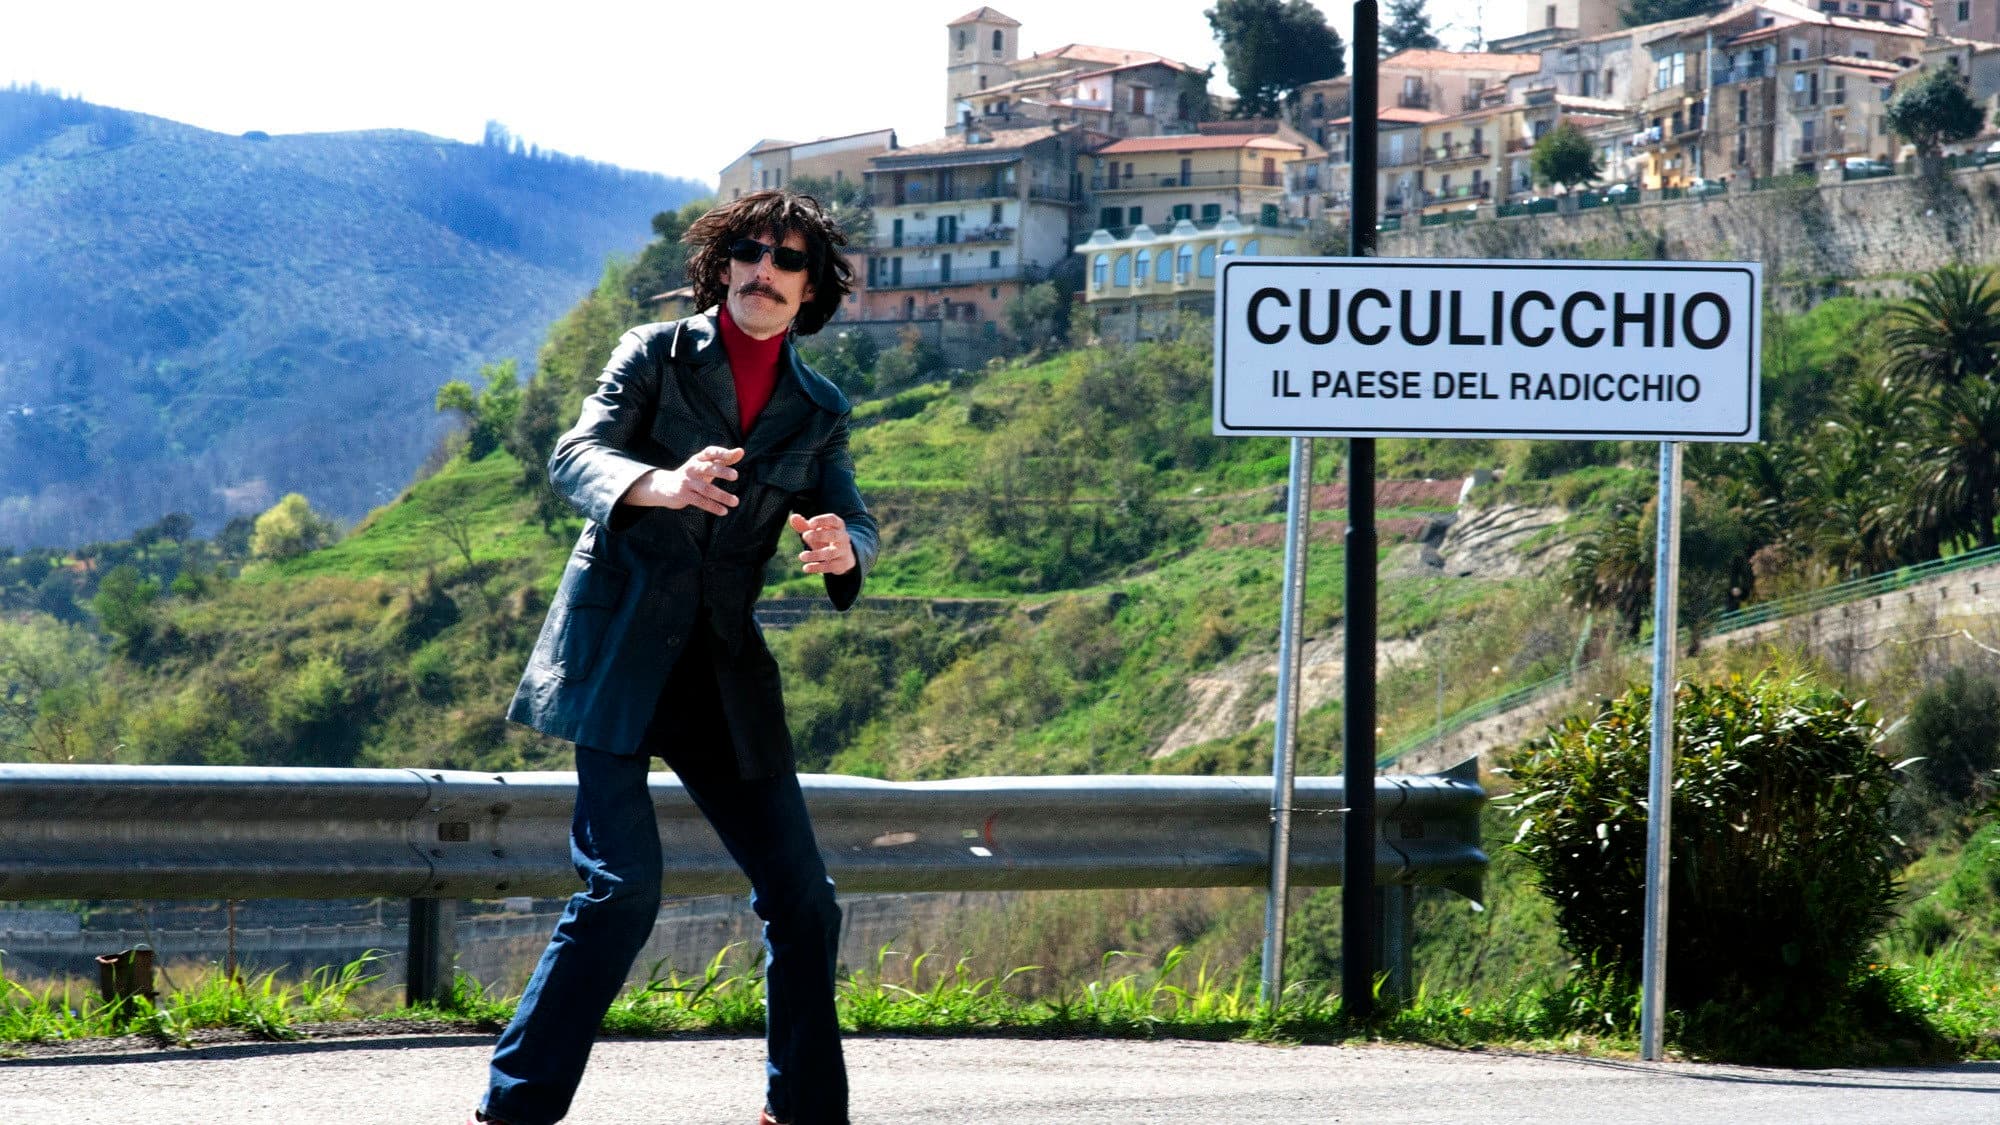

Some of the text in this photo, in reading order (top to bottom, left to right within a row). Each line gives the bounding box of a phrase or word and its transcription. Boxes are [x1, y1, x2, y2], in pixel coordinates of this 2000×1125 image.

[1246, 286, 1732, 350] CUCULICCHIO
[1272, 369, 1701, 404] IL PAESE DEL RADICCHIO
